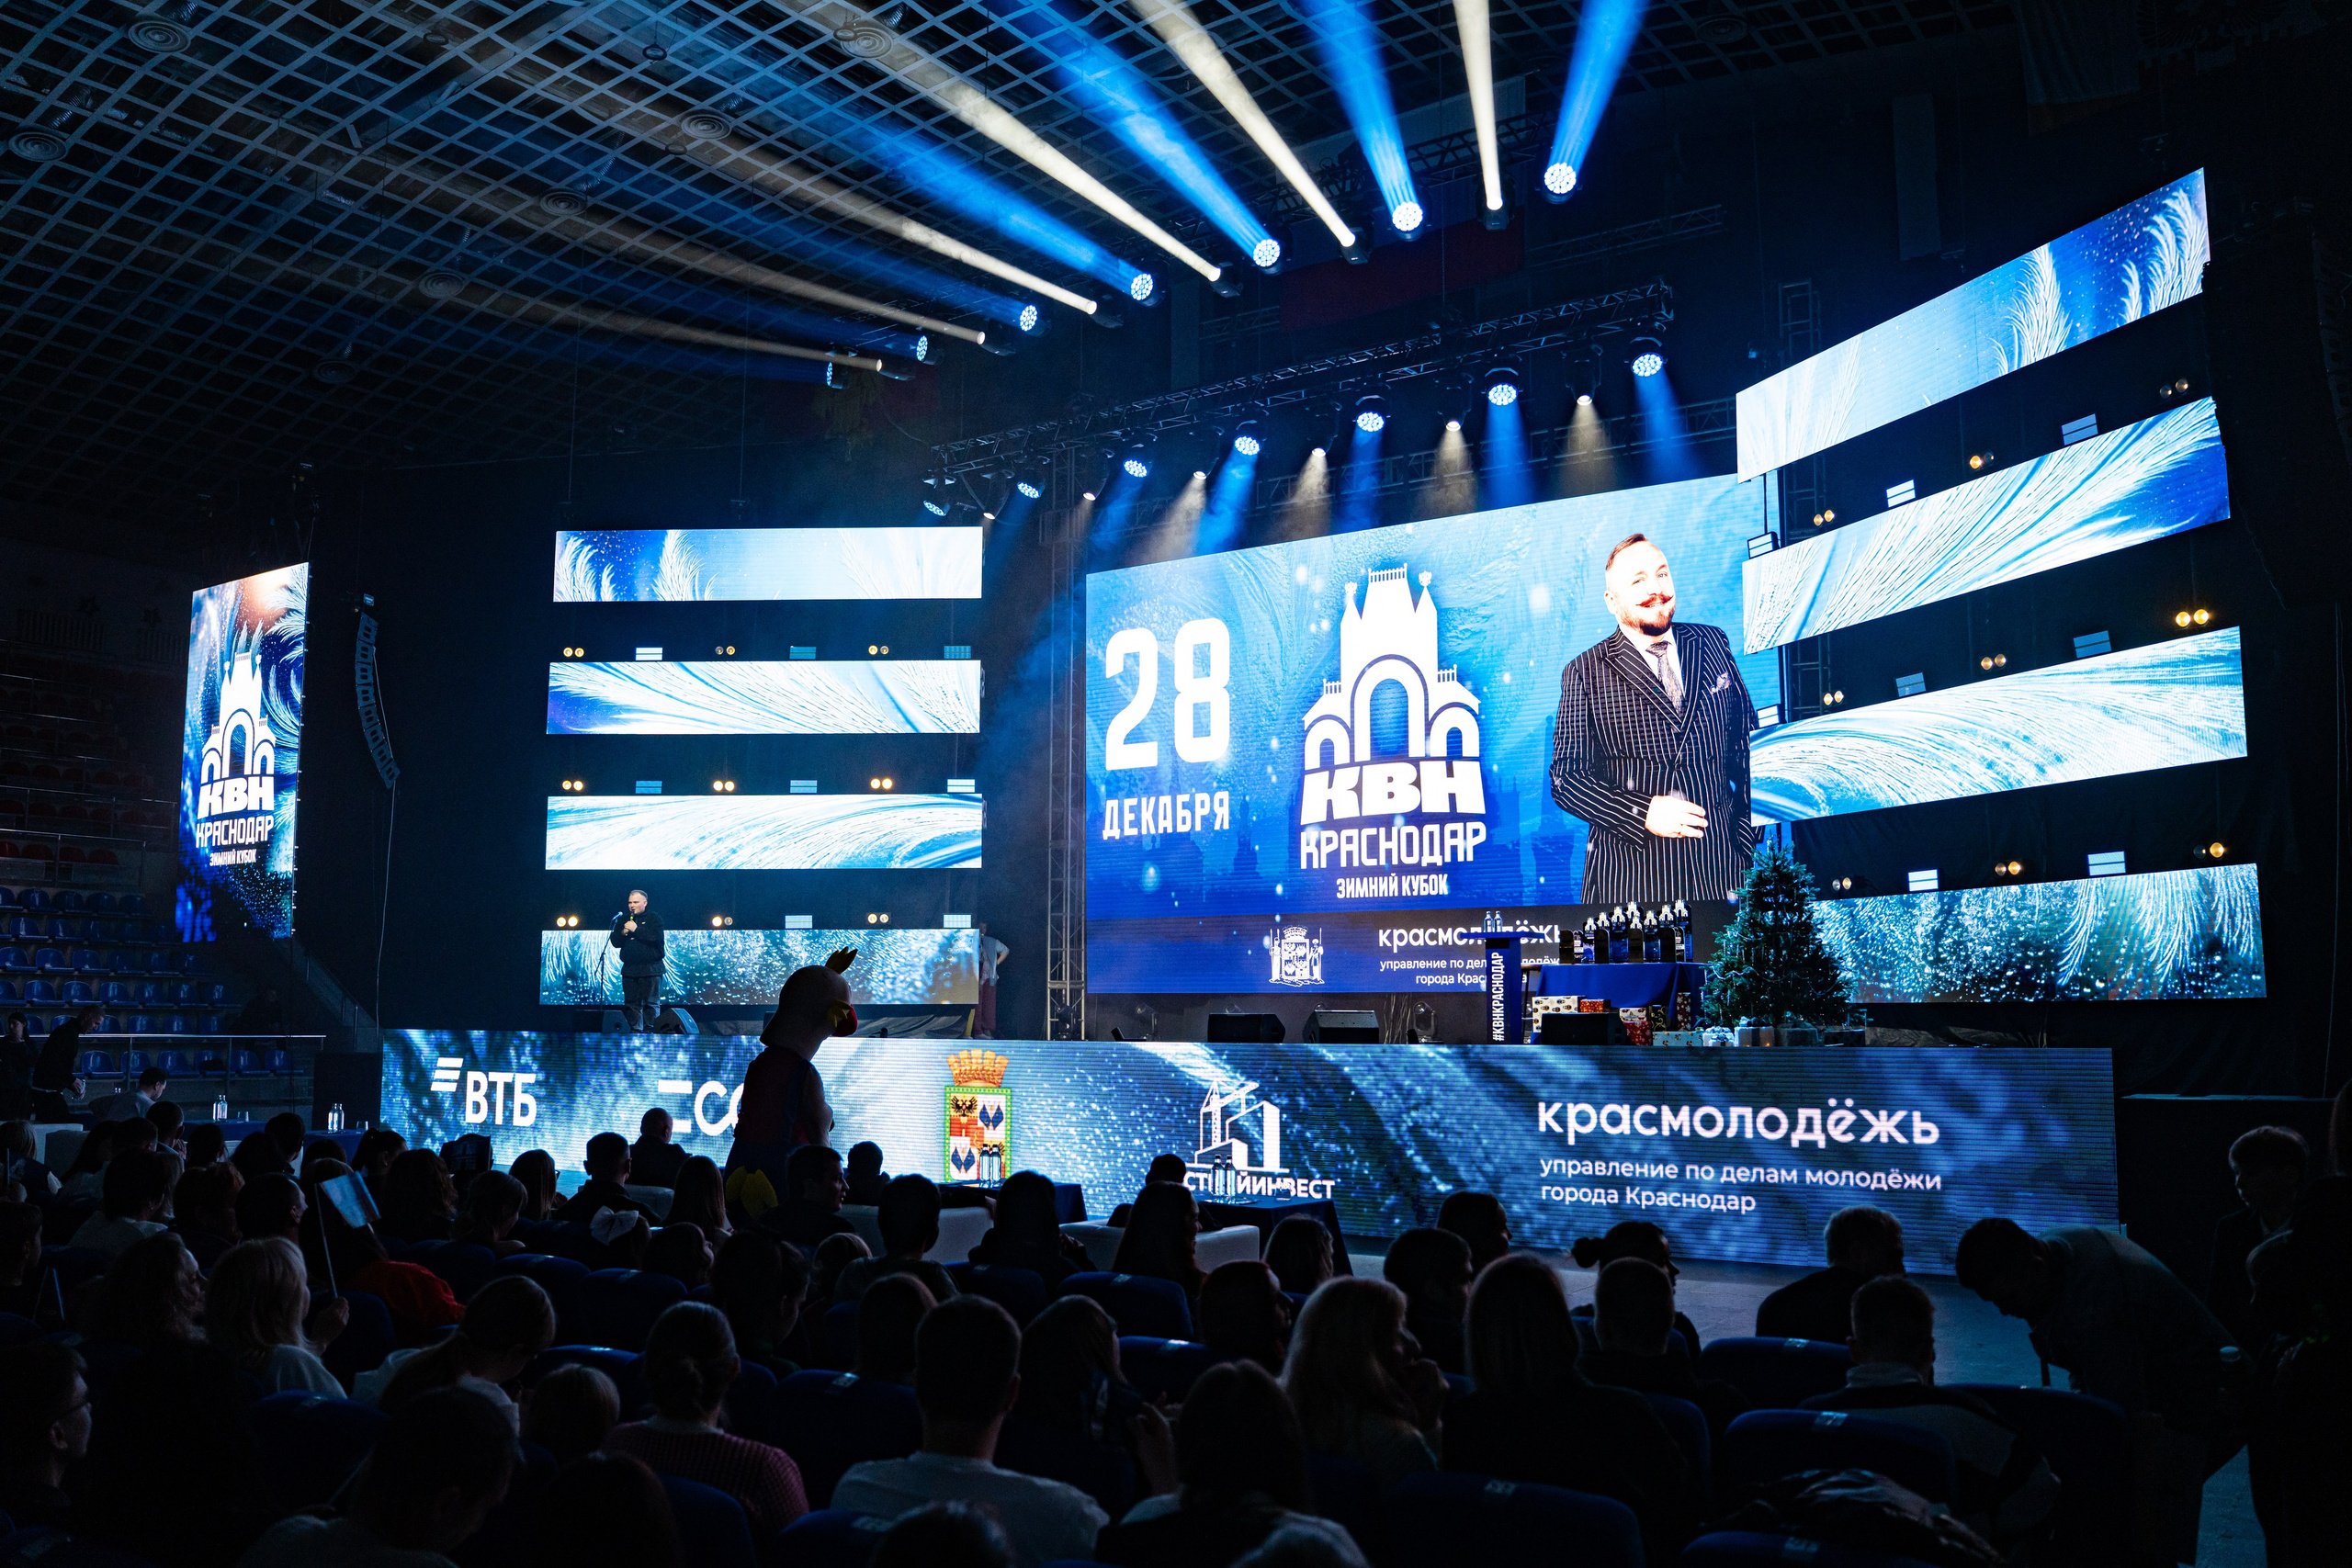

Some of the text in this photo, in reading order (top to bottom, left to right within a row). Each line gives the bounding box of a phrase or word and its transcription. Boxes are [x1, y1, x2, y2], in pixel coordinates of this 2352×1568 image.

[1104, 617, 1230, 771] 28
[197, 776, 275, 819] КВН
[1300, 760, 1487, 825] КВН
[195, 815, 275, 849] КРАСНОДАР
[1102, 790, 1229, 840] ДЕКАБРЯ
[209, 849, 257, 866] ЗИМНИЙ КУБОК
[1300, 821, 1487, 869] КРАСНОДАР
[1336, 872, 1449, 899] ЗИМНИЙ КУБОК
[1378, 919, 1561, 953] красмолёж
[1379, 959, 1447, 972] управление
[1450, 959, 1464, 968] по
[1416, 975, 1454, 987] города
[1491, 952, 1505, 1042] #КВНКРАСНОДАР
[465, 1070, 537, 1127] ВТБ
[1537, 1098, 1940, 1149] красмолодёжь
[1183, 1171, 1336, 1199] СТЙИНВЕСТ
[1540, 1157, 1942, 1191] управление по делам молодёжи
[1541, 1183, 1756, 1214] города Краснодар
